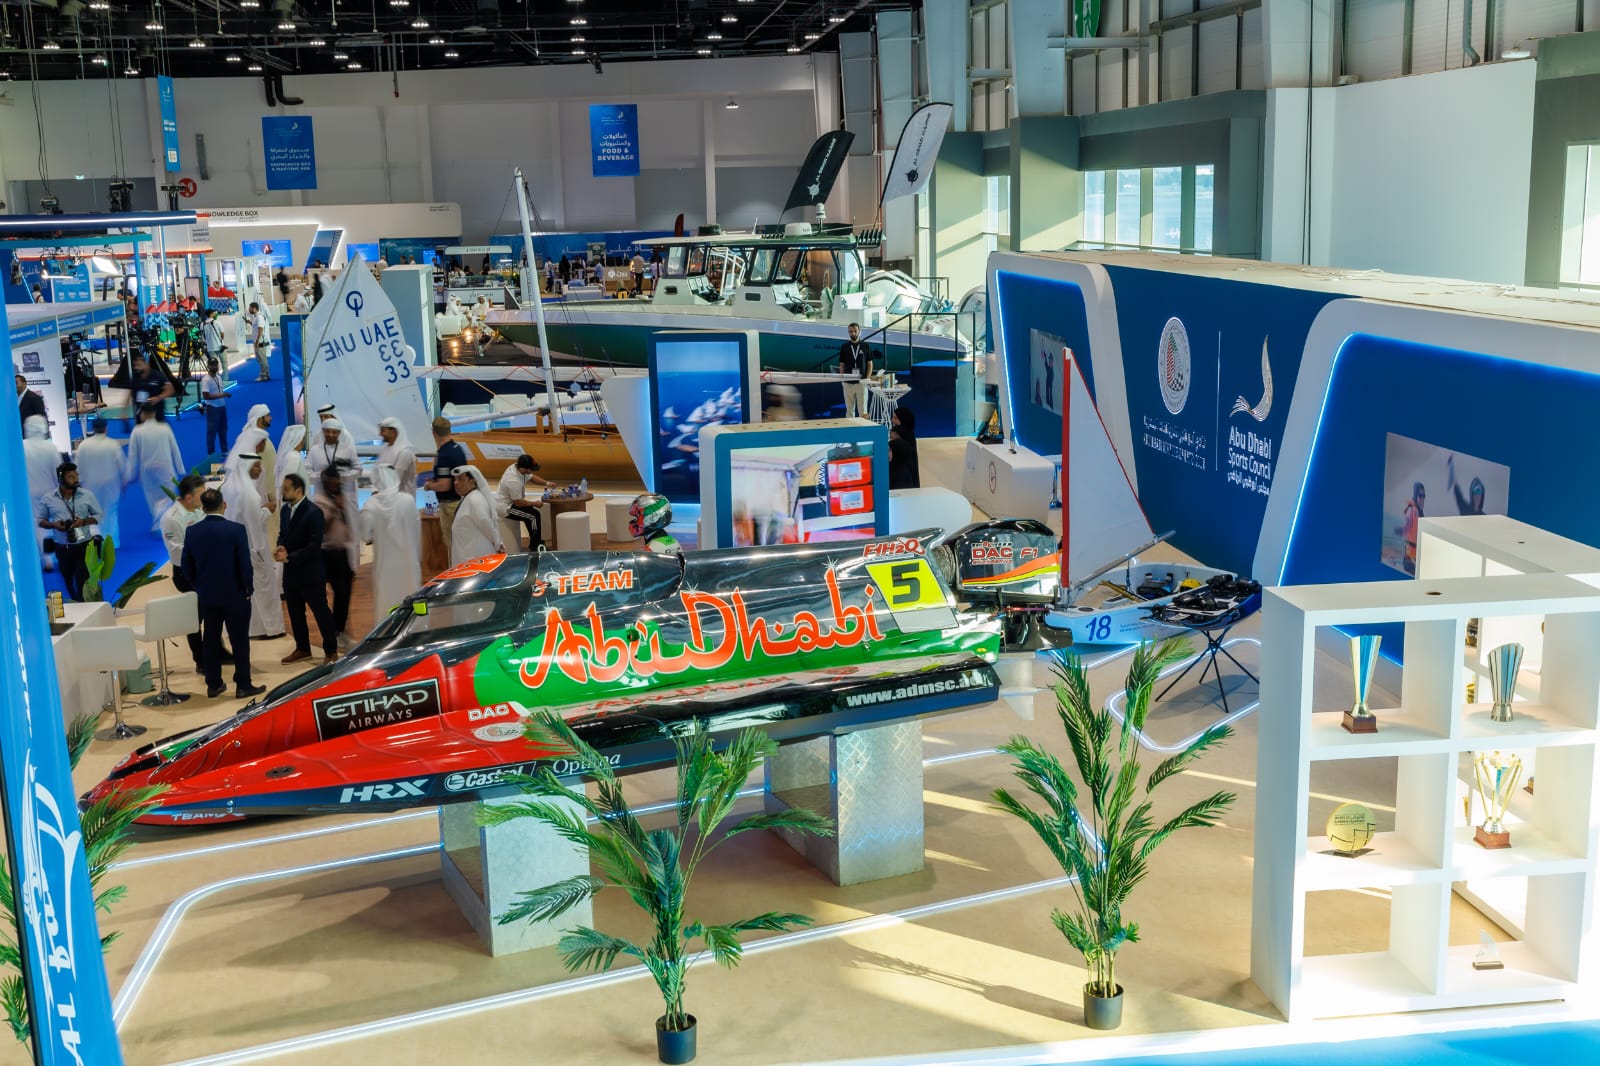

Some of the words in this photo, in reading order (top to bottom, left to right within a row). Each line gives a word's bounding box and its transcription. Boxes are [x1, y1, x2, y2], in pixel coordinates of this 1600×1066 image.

[360, 317, 399, 346] UAE
[385, 360, 410, 383] 33
[1229, 425, 1246, 450] Abu
[1247, 431, 1271, 460] Dhabi
[1228, 447, 1248, 471] Sports
[1248, 455, 1271, 480] Council
[972, 547, 1013, 559] DAC
[1020, 547, 1038, 559] F1
[556, 569, 633, 595] TEAM
[891, 562, 921, 605] 5
[519, 601, 691, 689] Abu
[679, 567, 887, 669] Dhabi
[1085, 614, 1112, 641] 18
[326, 688, 429, 719] ETIHAD
[467, 703, 510, 721] DAC
[348, 708, 413, 730] AIRWAYS
[340, 779, 430, 804] HRX
